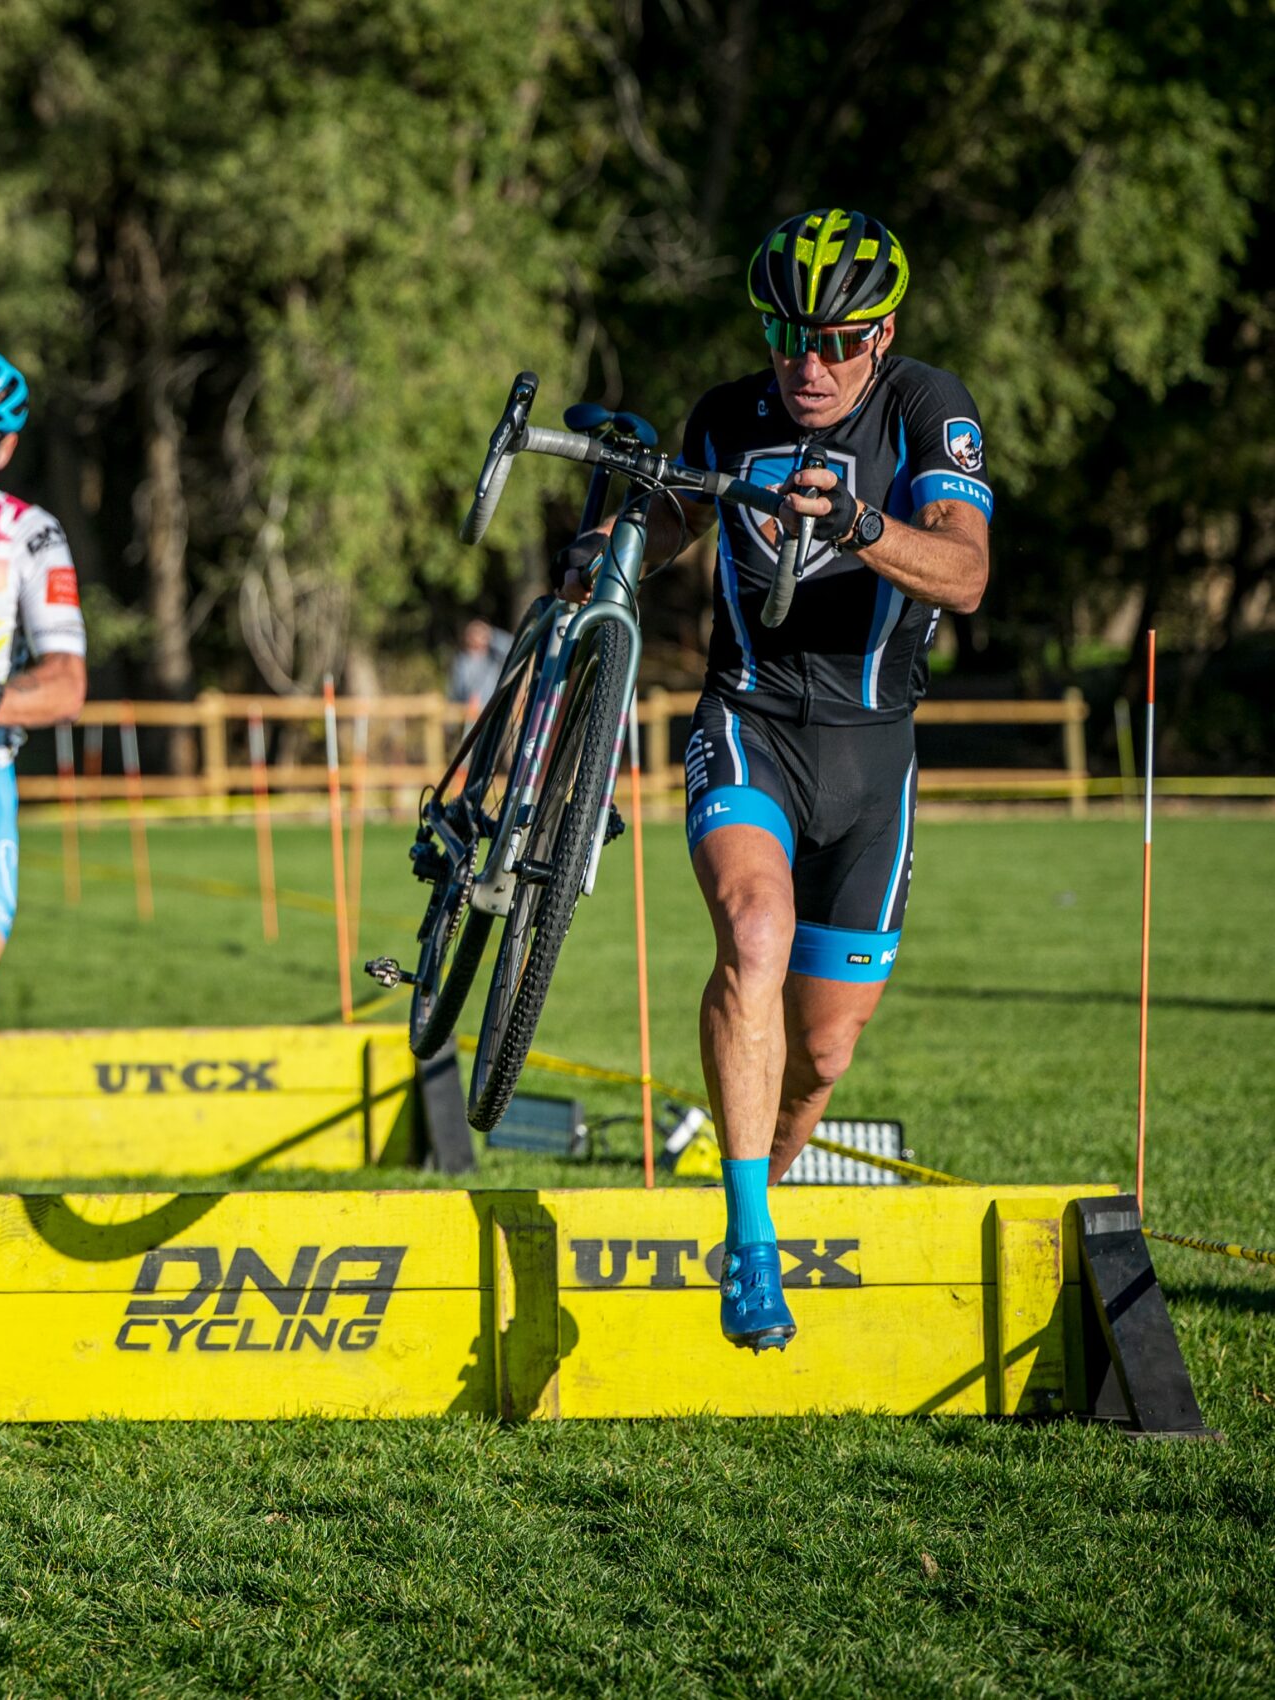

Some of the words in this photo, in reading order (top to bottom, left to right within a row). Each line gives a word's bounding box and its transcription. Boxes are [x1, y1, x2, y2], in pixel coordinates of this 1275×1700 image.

[94, 1060, 281, 1095] UTCX
[125, 1245, 409, 1316] DNA
[114, 1318, 383, 1352] CYCLING
